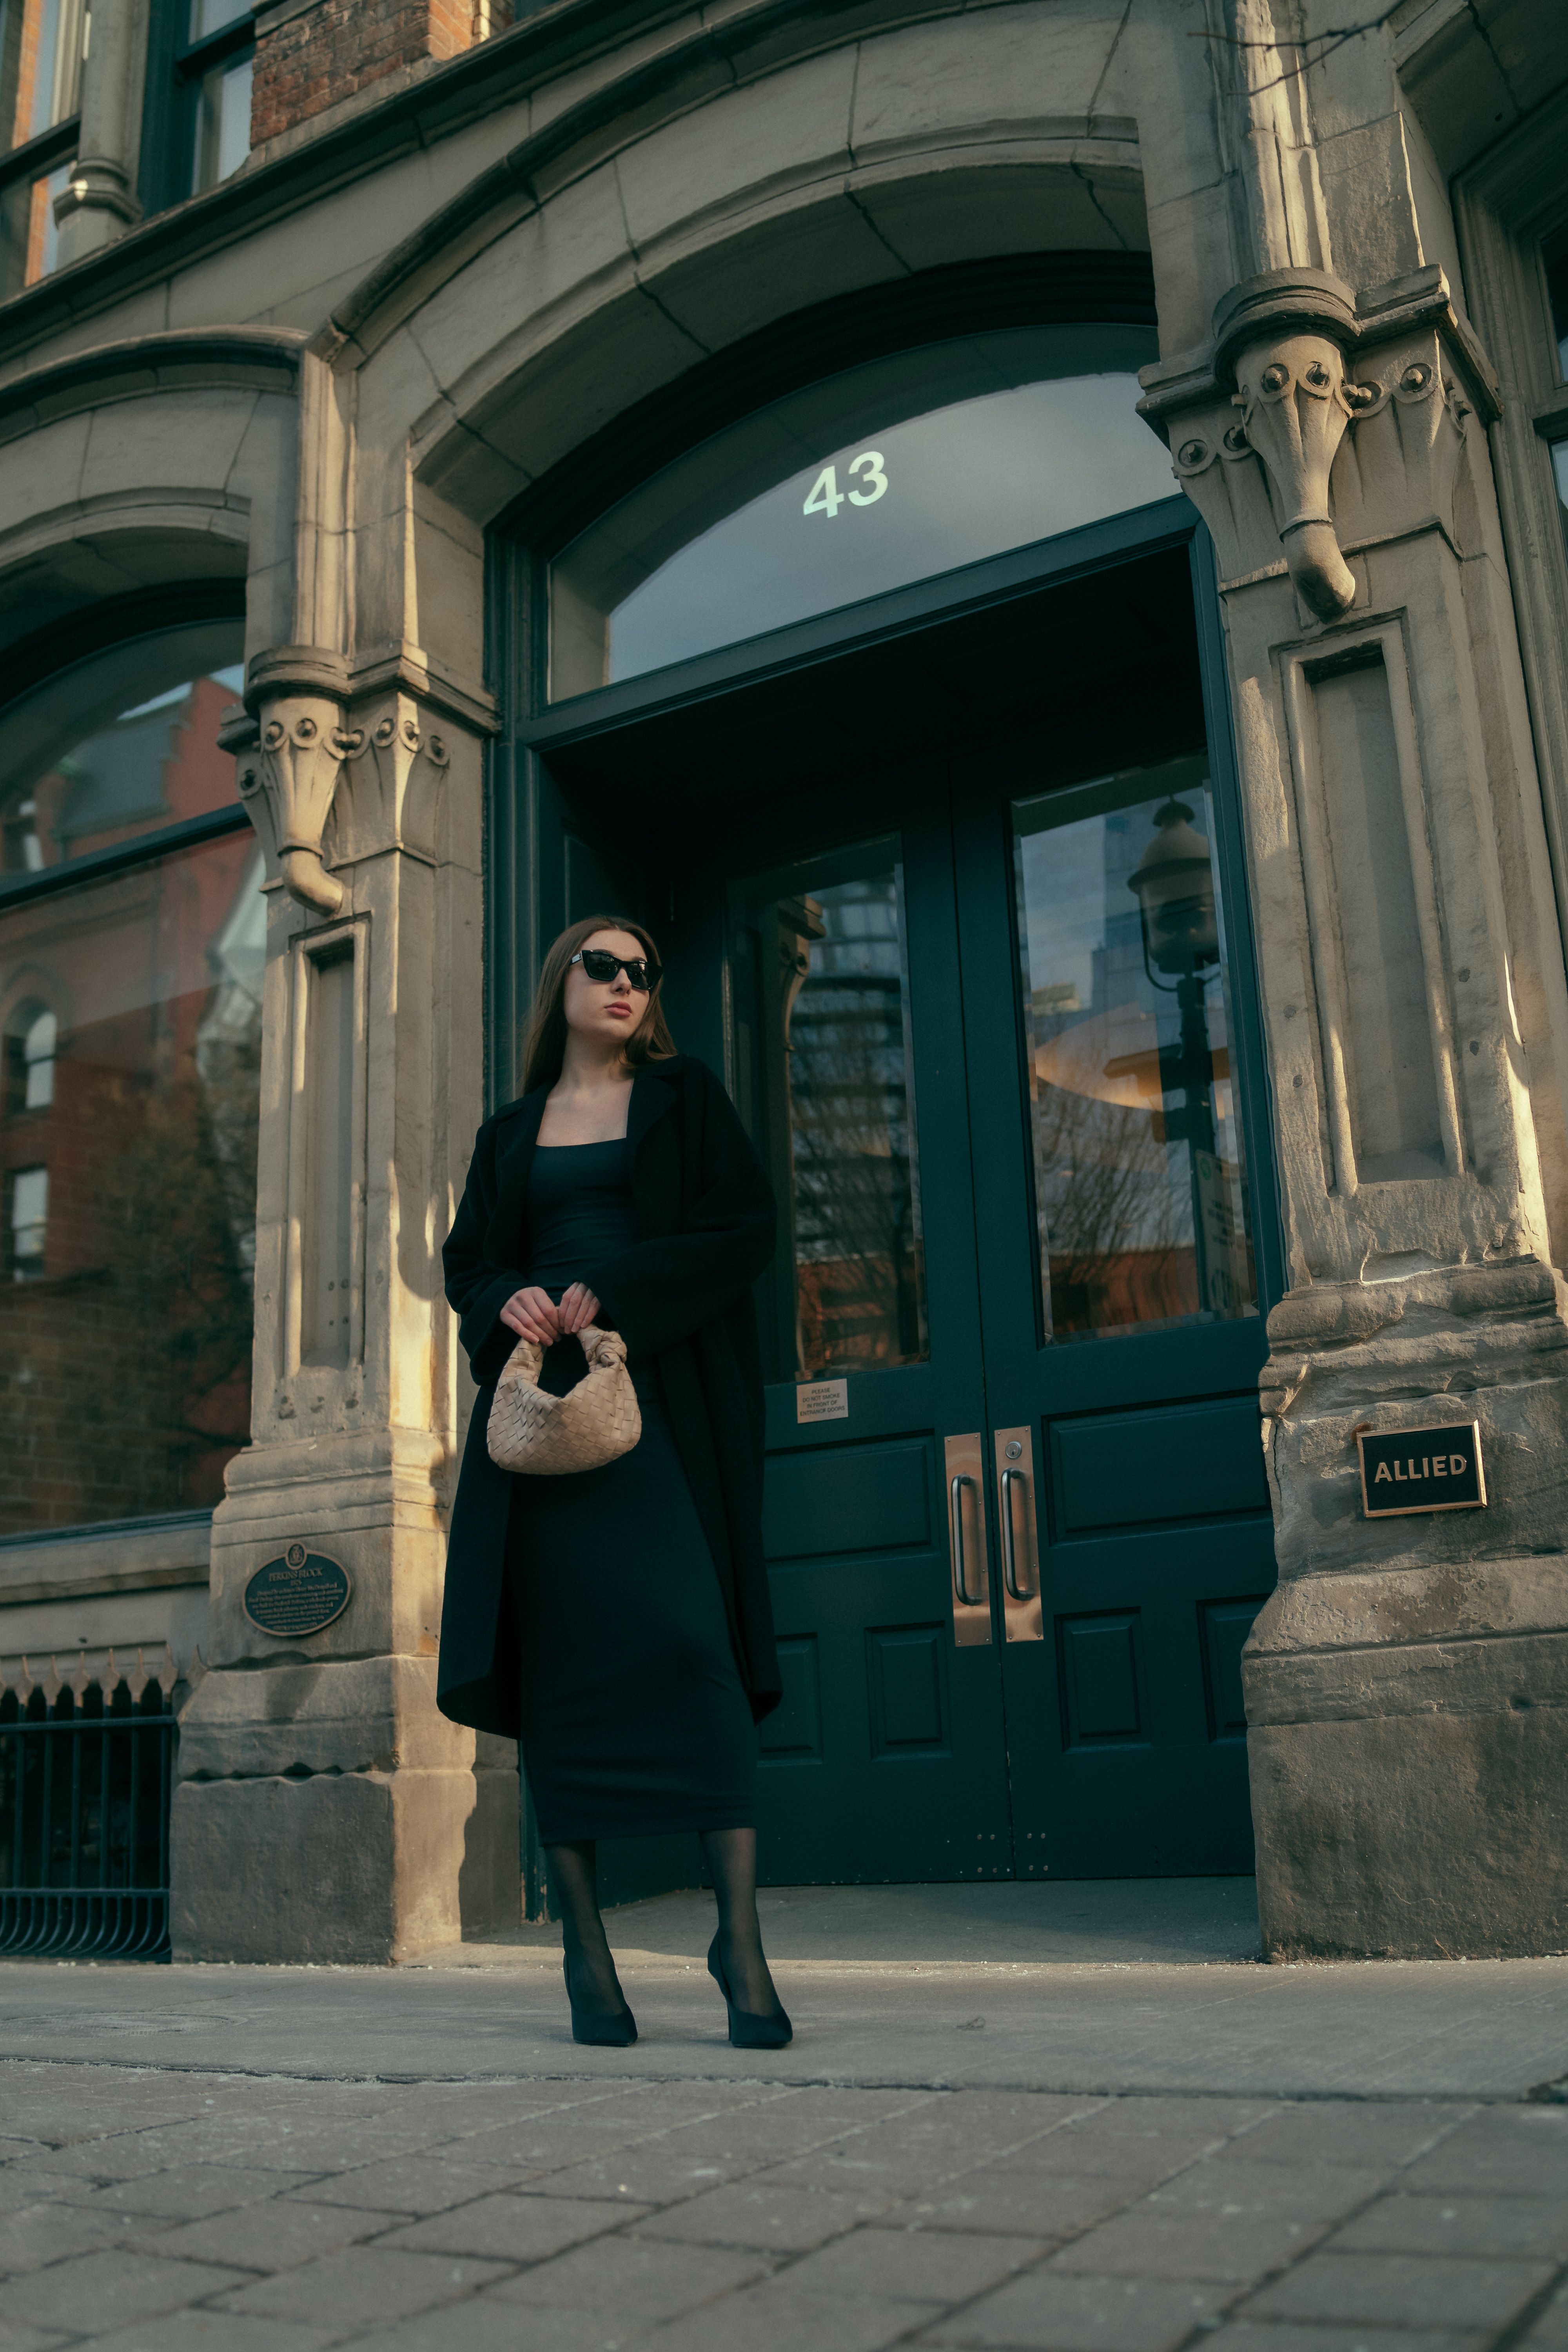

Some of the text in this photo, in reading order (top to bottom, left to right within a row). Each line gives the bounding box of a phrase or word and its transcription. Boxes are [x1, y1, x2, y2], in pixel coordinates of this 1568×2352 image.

[803, 451, 888, 518] 43
[800, 1408, 826, 1416] ENTRANCE
[1374, 1454, 1467, 1483] ALLIED
[298, 1568, 323, 1579] BLOCK
